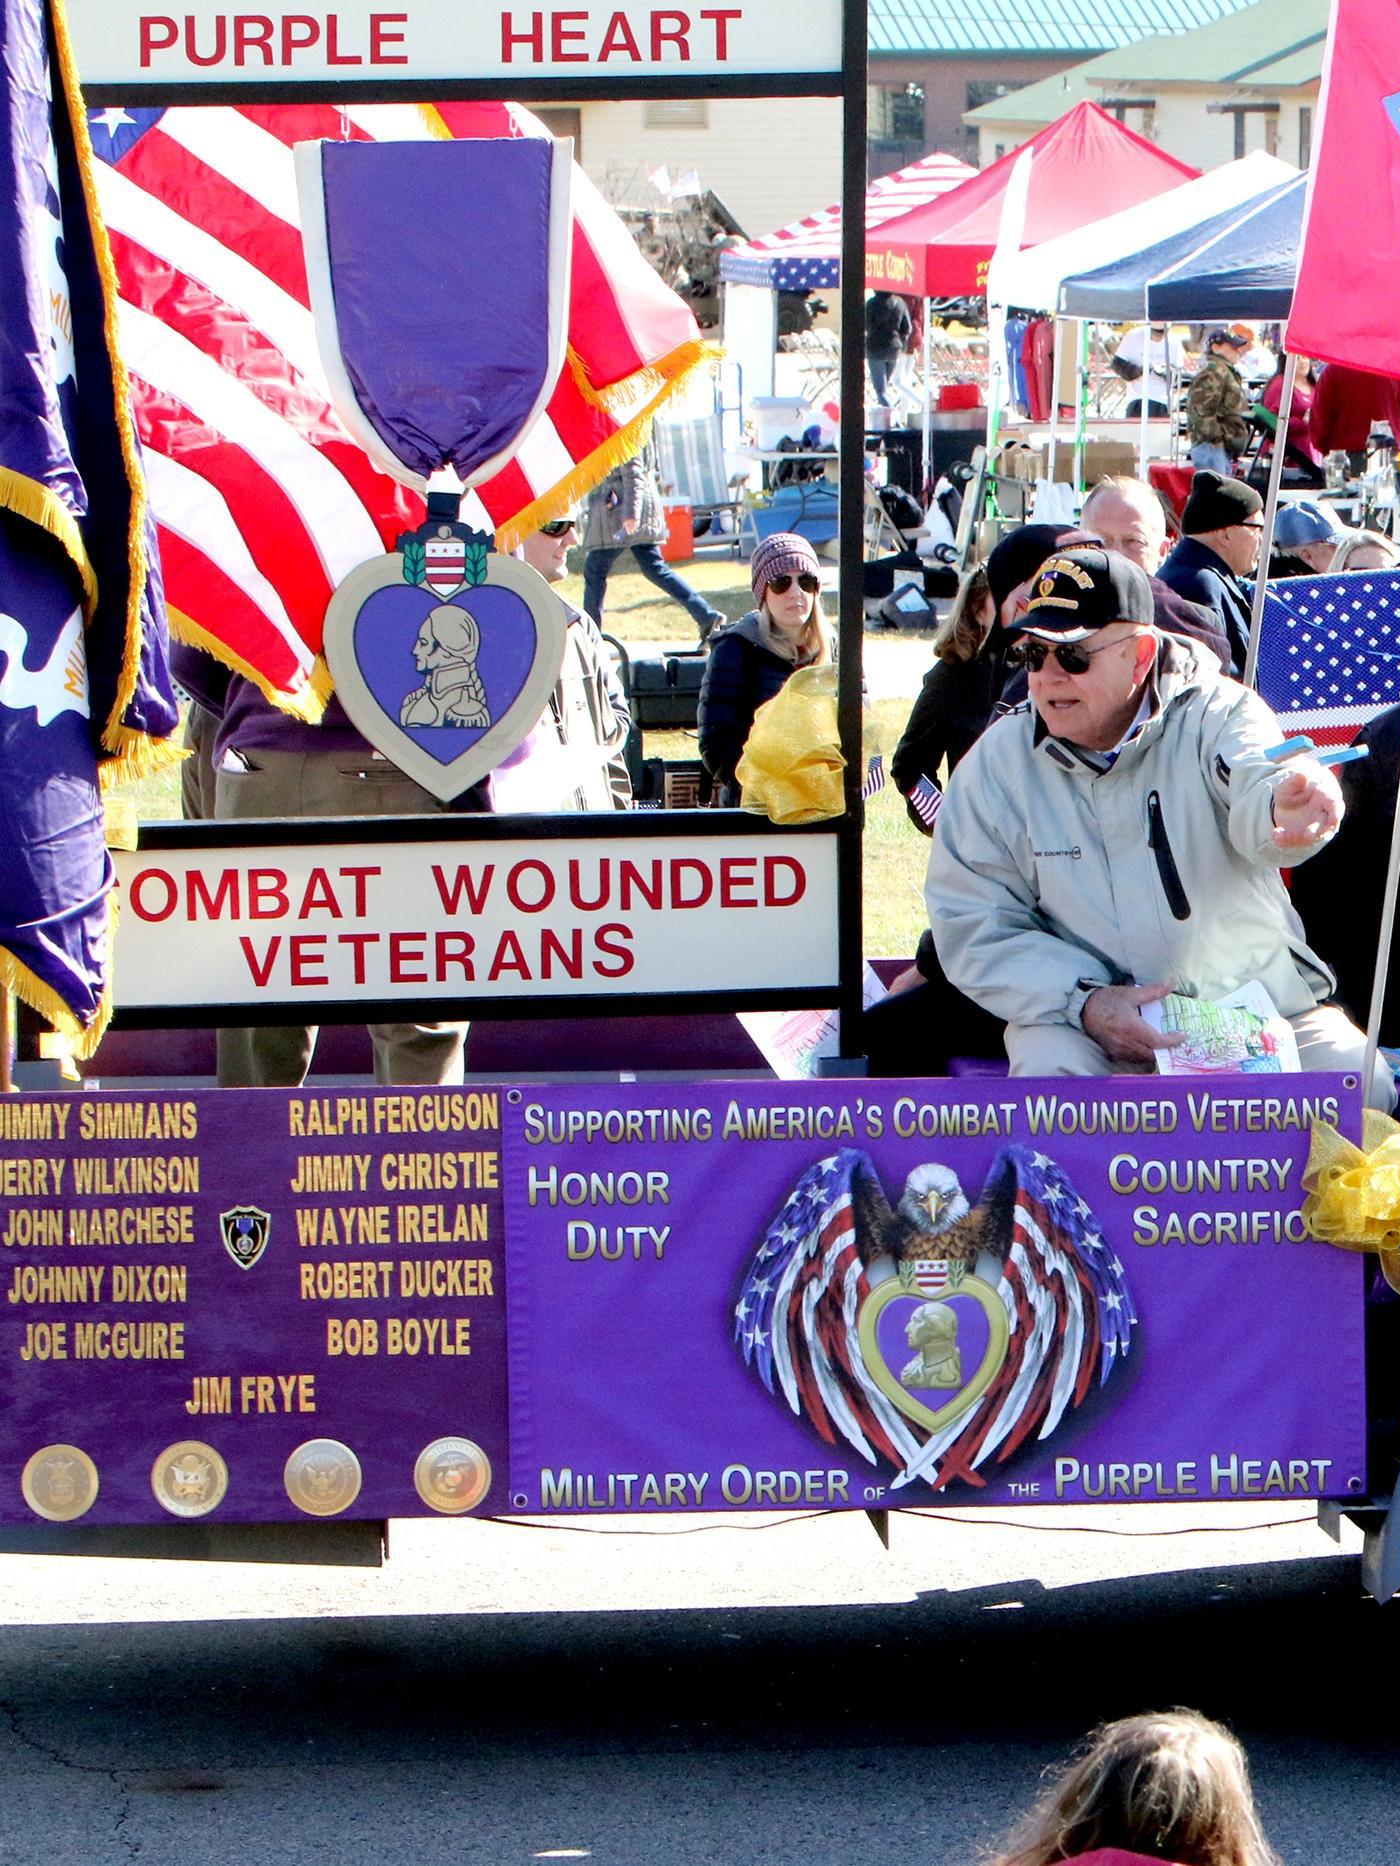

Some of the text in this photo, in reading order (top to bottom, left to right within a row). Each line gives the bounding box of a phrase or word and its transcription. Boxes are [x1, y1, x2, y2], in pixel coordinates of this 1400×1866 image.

[140, 8, 743, 68] PURPLE HEART
[113, 854, 808, 923] OMBAT WOUNDED
[238, 922, 637, 988] VETERANS
[79, 1101, 198, 1140] SIMMANS
[289, 1092, 499, 1137] RALPH FERGUSON
[523, 1093, 1340, 1143] SUPPORTING AMERICA'S COMBAT WOUNDED VETERANS
[73, 1155, 200, 1195] WILKINSON
[290, 1151, 499, 1193] JIMMY CHRISTIE
[527, 1165, 671, 1206] HONOR
[1107, 1153, 1294, 1194] COUNTRY
[3, 1206, 195, 1247] JOHN MARCHESE
[296, 1203, 488, 1247] WAYNE IRELAN
[567, 1220, 672, 1261] DUTY
[1133, 1205, 1310, 1248] SACRIFIC
[8, 1265, 187, 1304] JOHNNY DIXON
[300, 1258, 494, 1300] ROBERT DUCKER
[20, 1322, 185, 1361] JOE MCGUIRE
[327, 1318, 471, 1356] BOB BOYLE
[185, 1375, 316, 1415] JIM FRYE
[540, 1454, 1333, 1508] MILITARY ORDER OF THE PURPLE HEART
